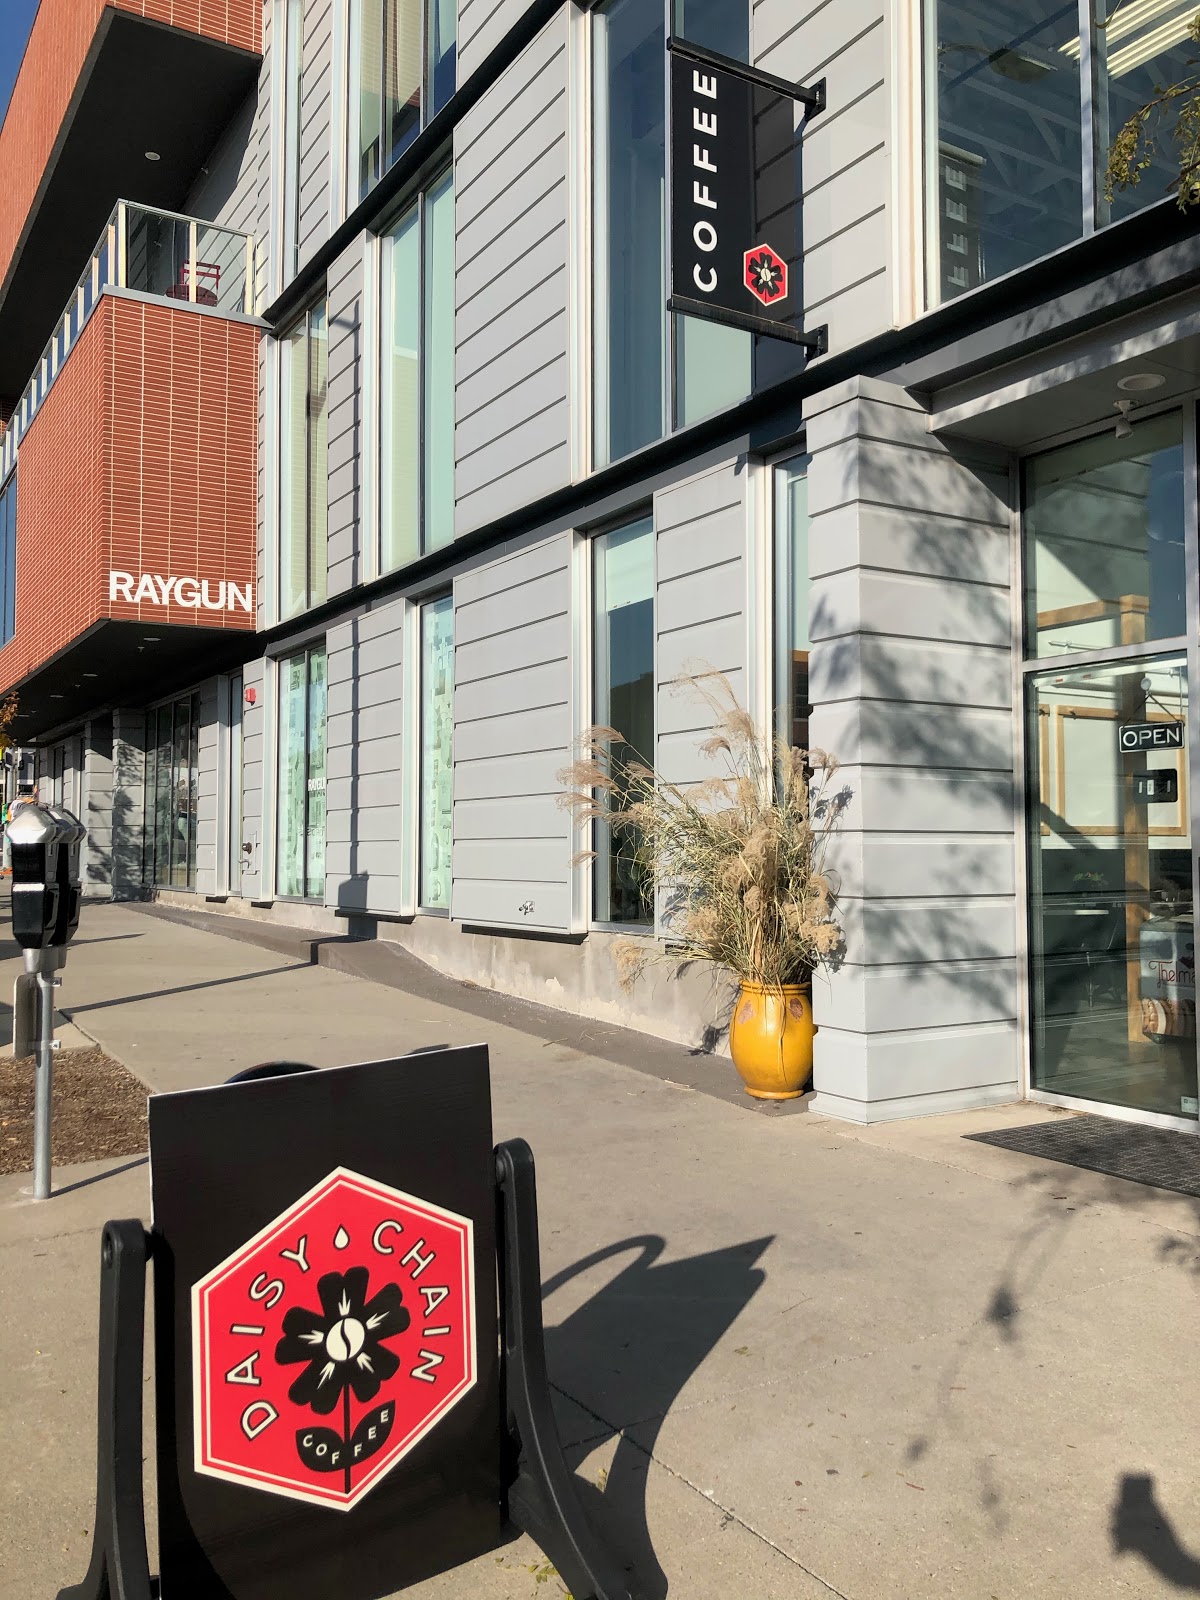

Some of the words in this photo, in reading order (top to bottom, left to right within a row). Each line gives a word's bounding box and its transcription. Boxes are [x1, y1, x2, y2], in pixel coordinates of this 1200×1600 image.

[693, 69, 718, 293] COFFEE
[109, 570, 252, 612] RAYGUN
[1122, 727, 1180, 747] OPEN
[225, 1234, 311, 1442] DAISY
[371, 1219, 452, 1386] CHAIN
[302, 1409, 389, 1465] COFFEE
